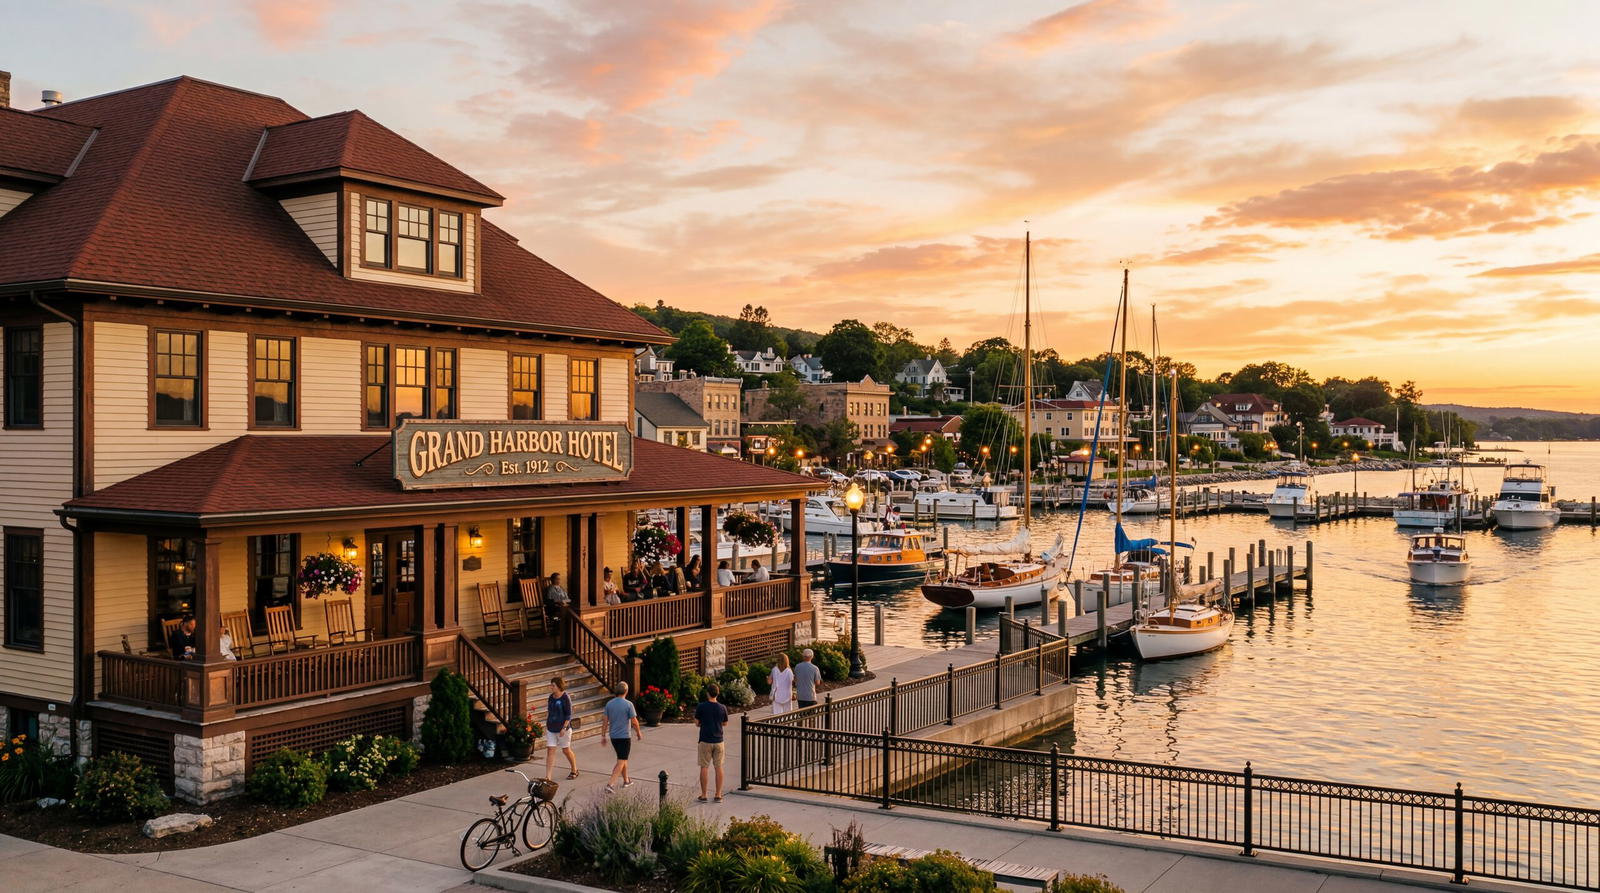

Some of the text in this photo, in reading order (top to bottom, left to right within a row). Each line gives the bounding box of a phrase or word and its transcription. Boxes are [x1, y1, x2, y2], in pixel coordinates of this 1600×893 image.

[410, 430, 624, 477] GRAND HARBOR HOTEL
[501, 460, 549, 475] Est. 1912
